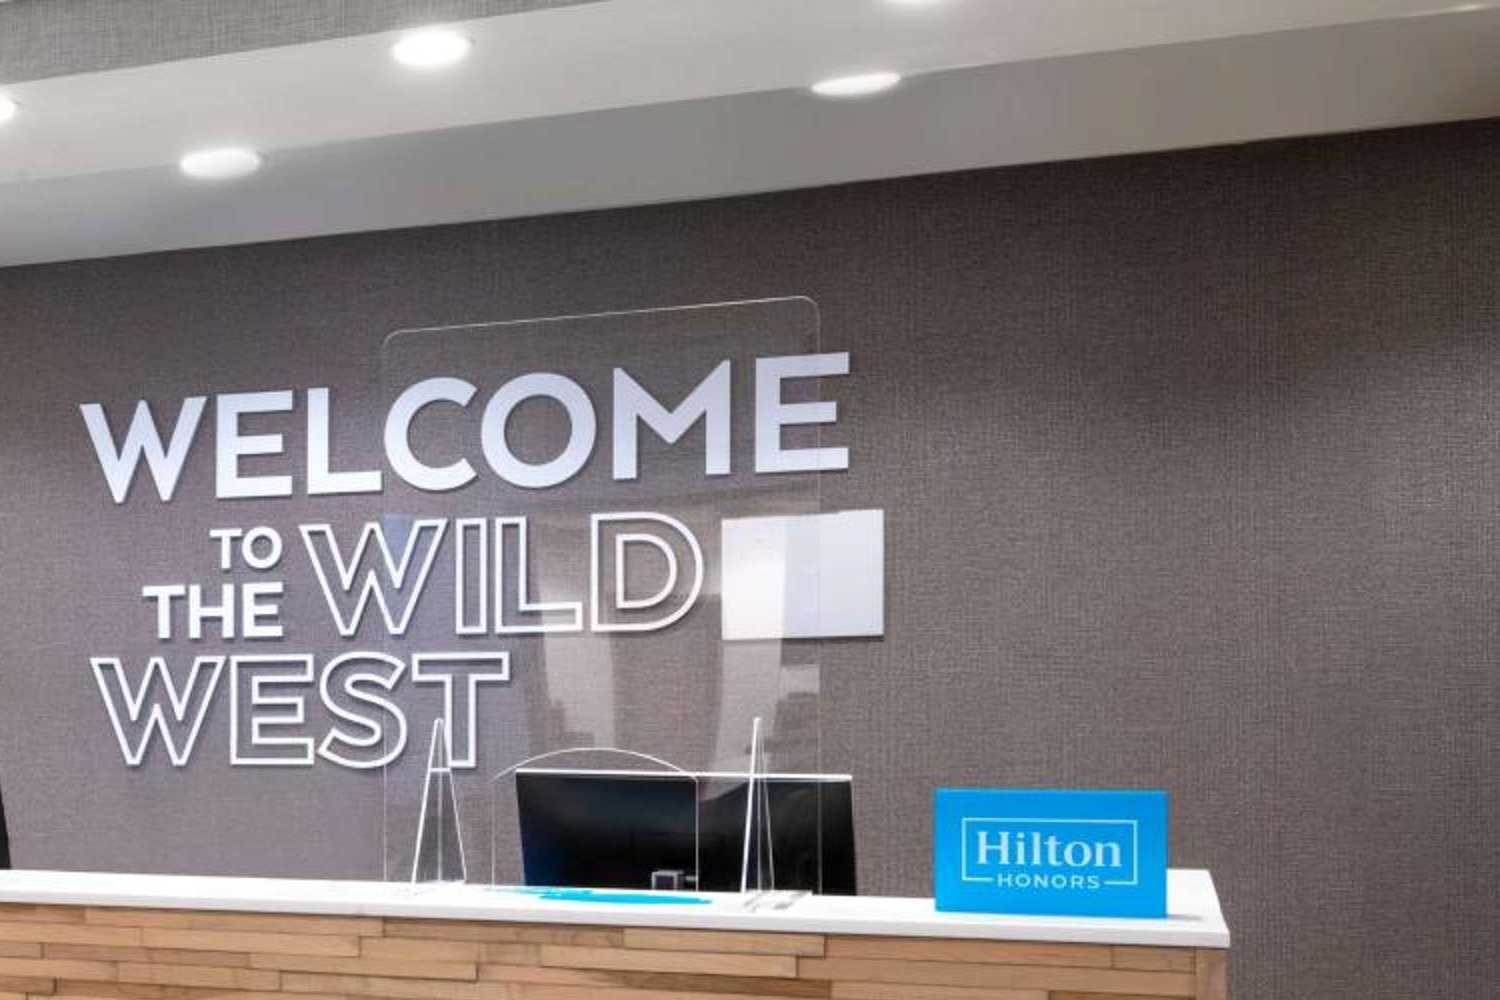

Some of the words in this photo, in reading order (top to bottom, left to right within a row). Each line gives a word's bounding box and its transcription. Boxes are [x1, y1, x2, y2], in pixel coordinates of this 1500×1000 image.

[80, 352, 850, 504] WELCOME
[142, 582, 284, 640] THE
[299, 512, 706, 637] WILD
[209, 526, 283, 569] TO
[90, 651, 510, 770] WEST
[977, 831, 1122, 865] Hilton
[999, 872, 1100, 889] HONORS
